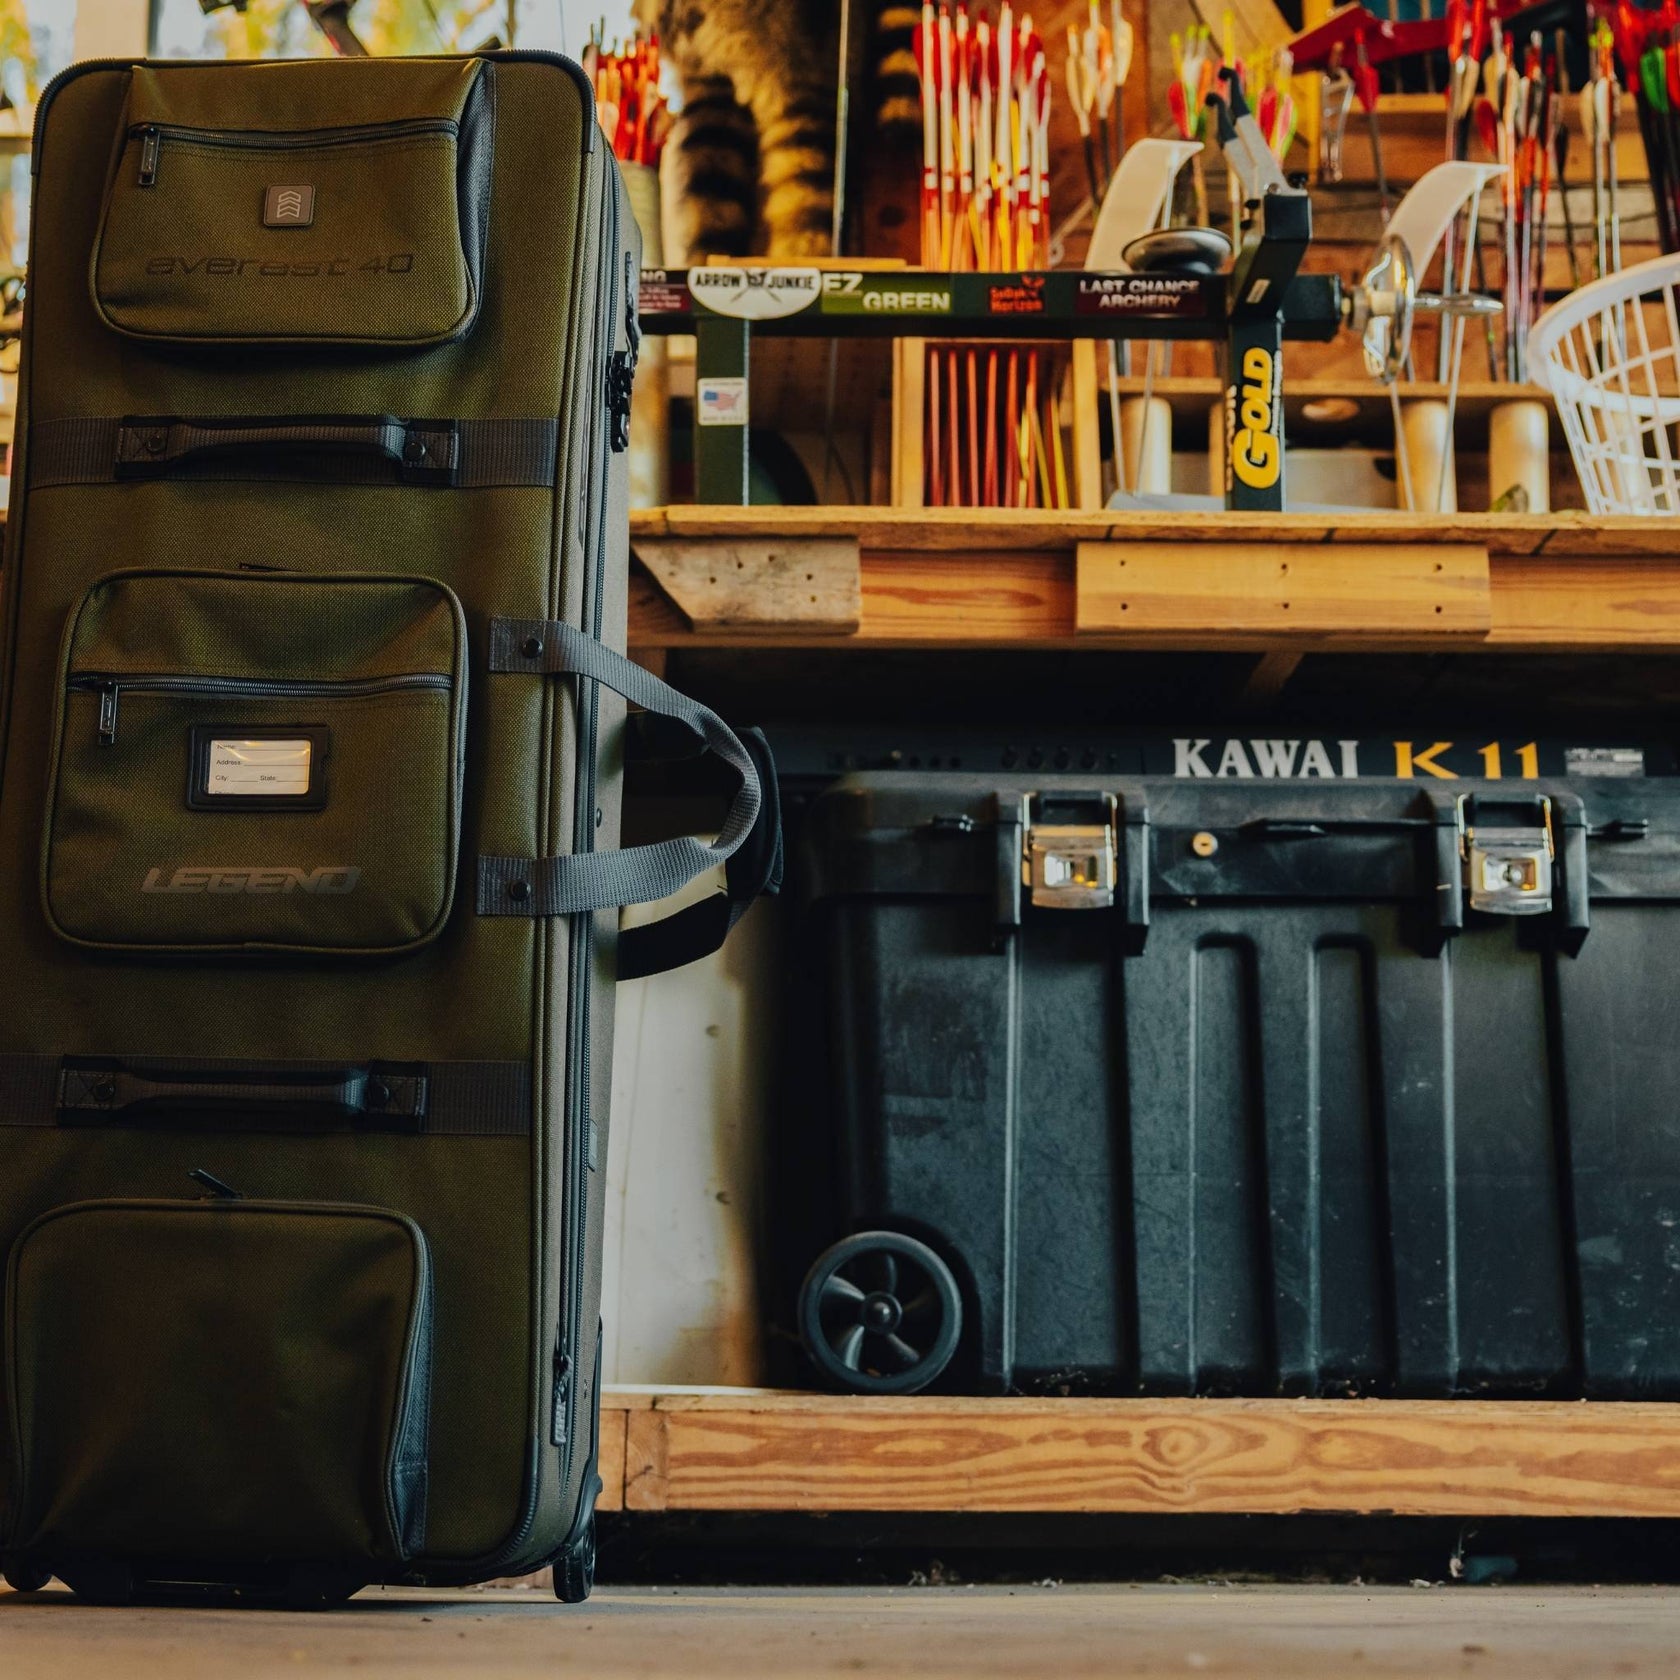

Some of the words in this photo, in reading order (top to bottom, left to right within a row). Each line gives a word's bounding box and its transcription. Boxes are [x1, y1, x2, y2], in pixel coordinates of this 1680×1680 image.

[360, 254, 413, 274] 40
[695, 273, 742, 287] ARROW
[768, 275, 815, 290] JUNKIE
[822, 273, 863, 293] EZ
[1080, 280, 1125, 293] LAST
[1129, 280, 1200, 294] CHANCE
[862, 292, 950, 310] GREEN
[1099, 295, 1181, 308] ARCHERY
[1232, 347, 1280, 489] GOLD
[1173, 739, 1359, 778] KAWAI
[1394, 742, 1459, 779] K
[141, 867, 361, 894] LEGEND
